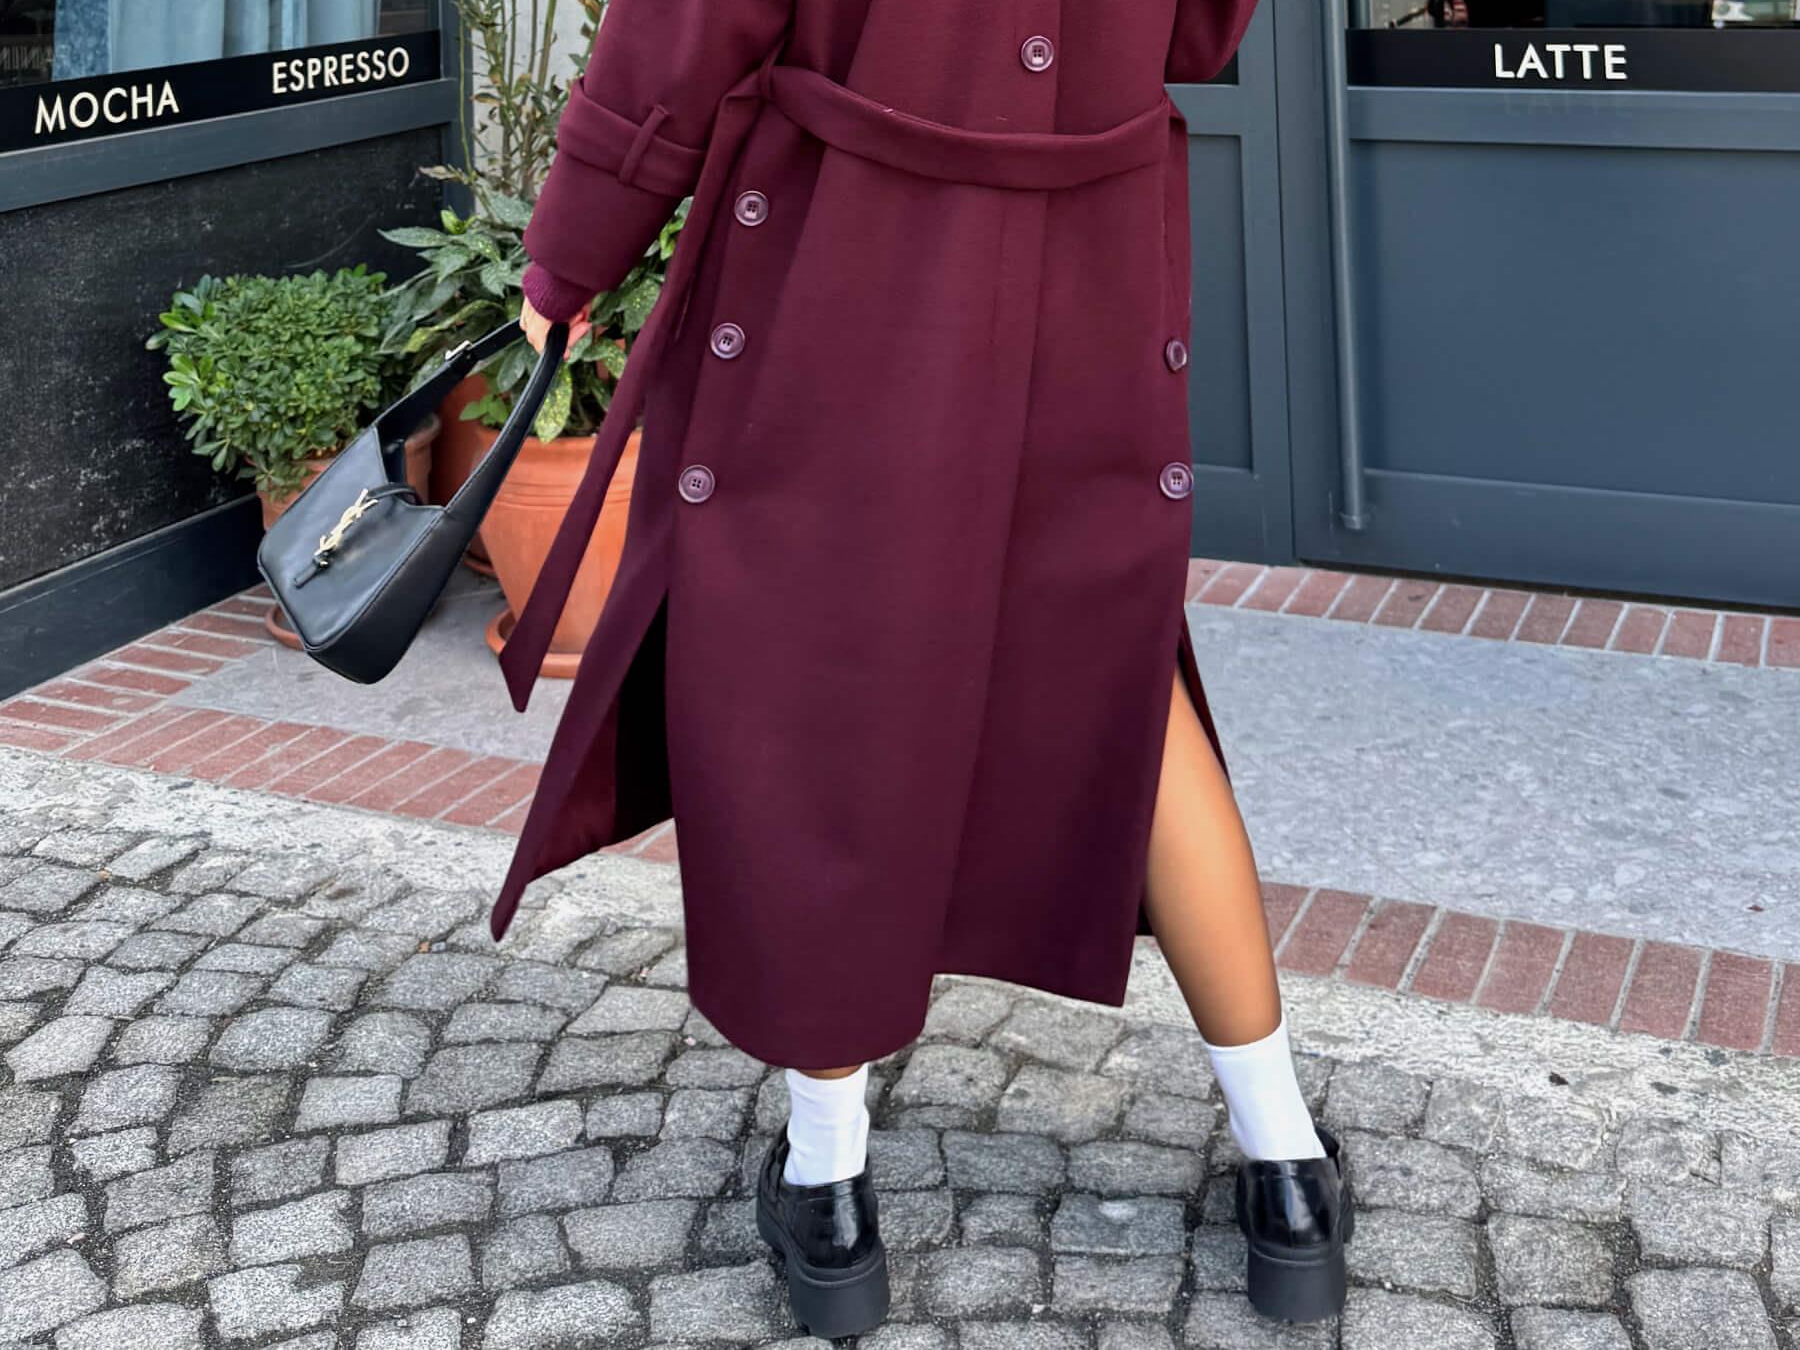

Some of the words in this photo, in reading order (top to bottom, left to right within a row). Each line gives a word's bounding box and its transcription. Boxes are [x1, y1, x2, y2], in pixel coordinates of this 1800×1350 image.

[34, 79, 180, 134] MOCHA
[271, 46, 410, 94] ESPRESSO
[1494, 42, 1628, 80] LATTE
